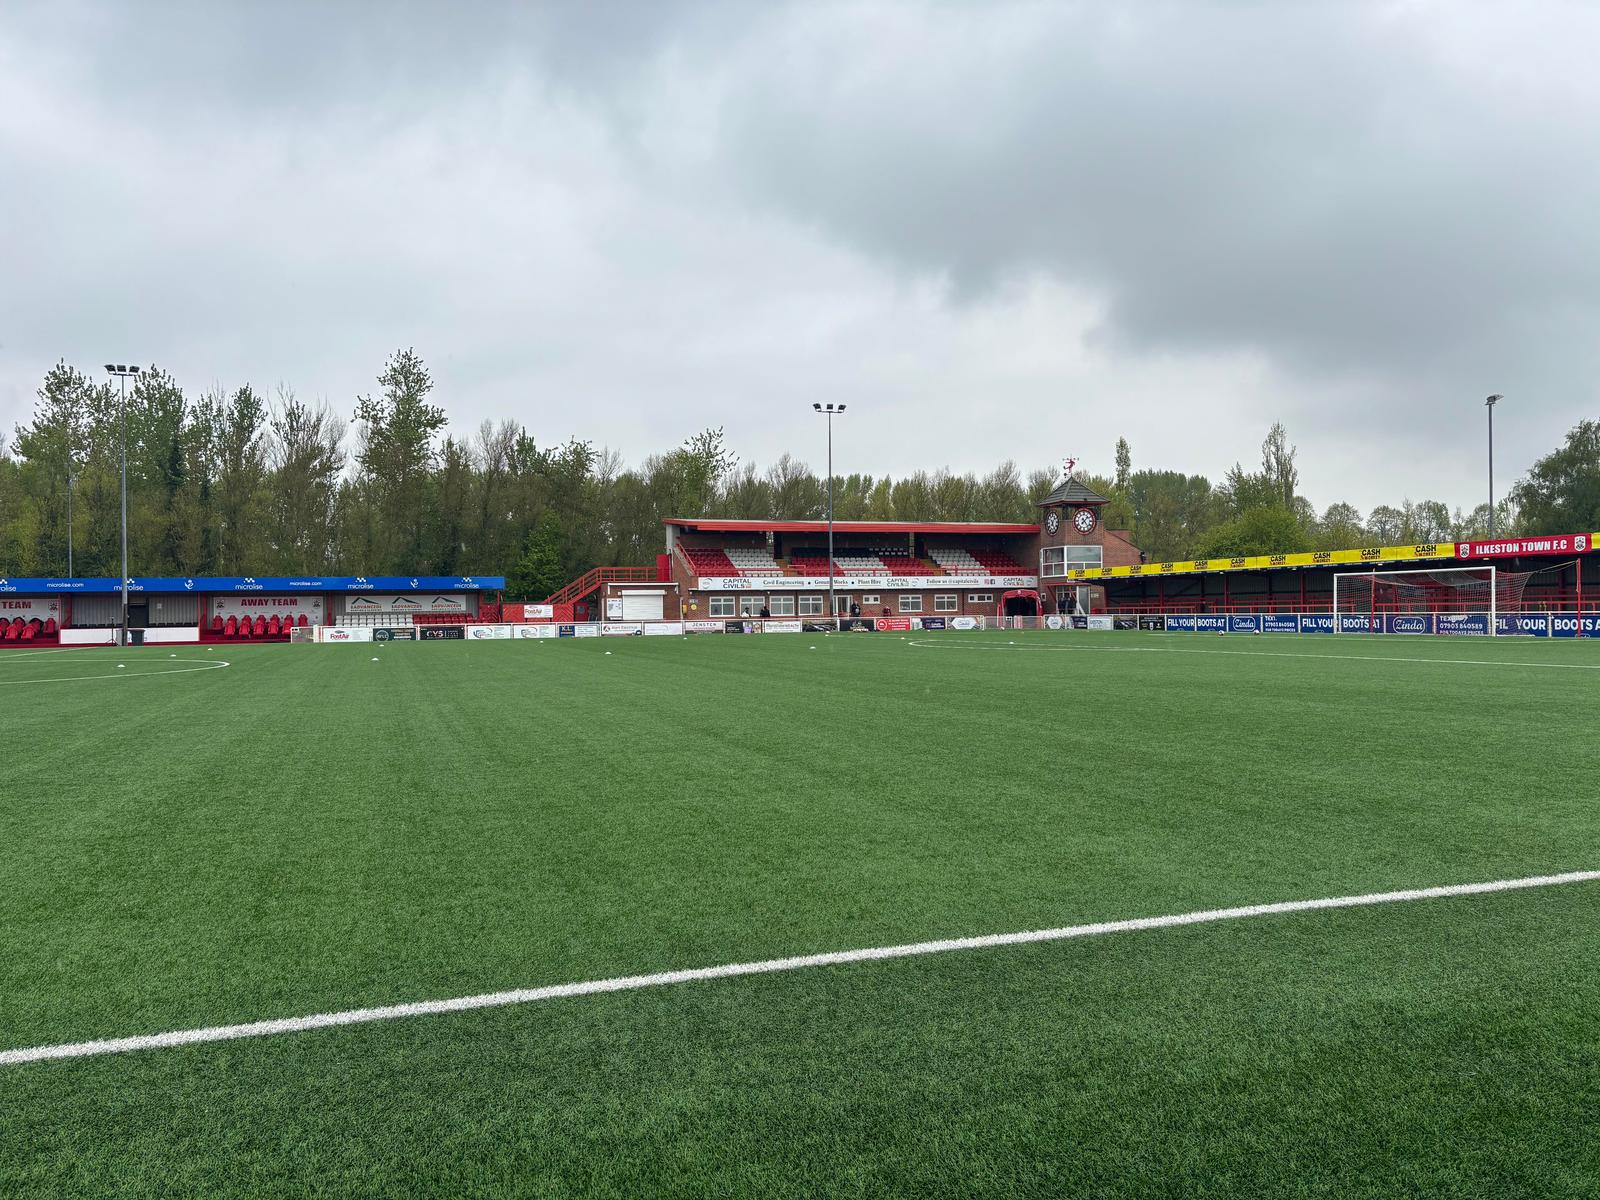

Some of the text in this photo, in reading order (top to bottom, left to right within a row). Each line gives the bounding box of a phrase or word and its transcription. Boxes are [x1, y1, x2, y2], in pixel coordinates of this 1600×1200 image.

[1476, 540, 1567, 555] ILKESTON TOWN F.C
[1, 601, 32, 609] TEAM
[271, 598, 298, 606] TEAM
[1168, 619, 1178, 627] FILL
[1179, 619, 1195, 627] YOUR
[1198, 619, 1225, 627] BOOTS AT
[1235, 619, 1254, 628] Zinda
[1302, 618, 1336, 627] FILL YOU
[1343, 619, 1369, 628] BOOTS
[1396, 620, 1423, 630] Zinda
[1494, 619, 1546, 630] FIL YOUR
[1554, 619, 1593, 630] BOOTS
